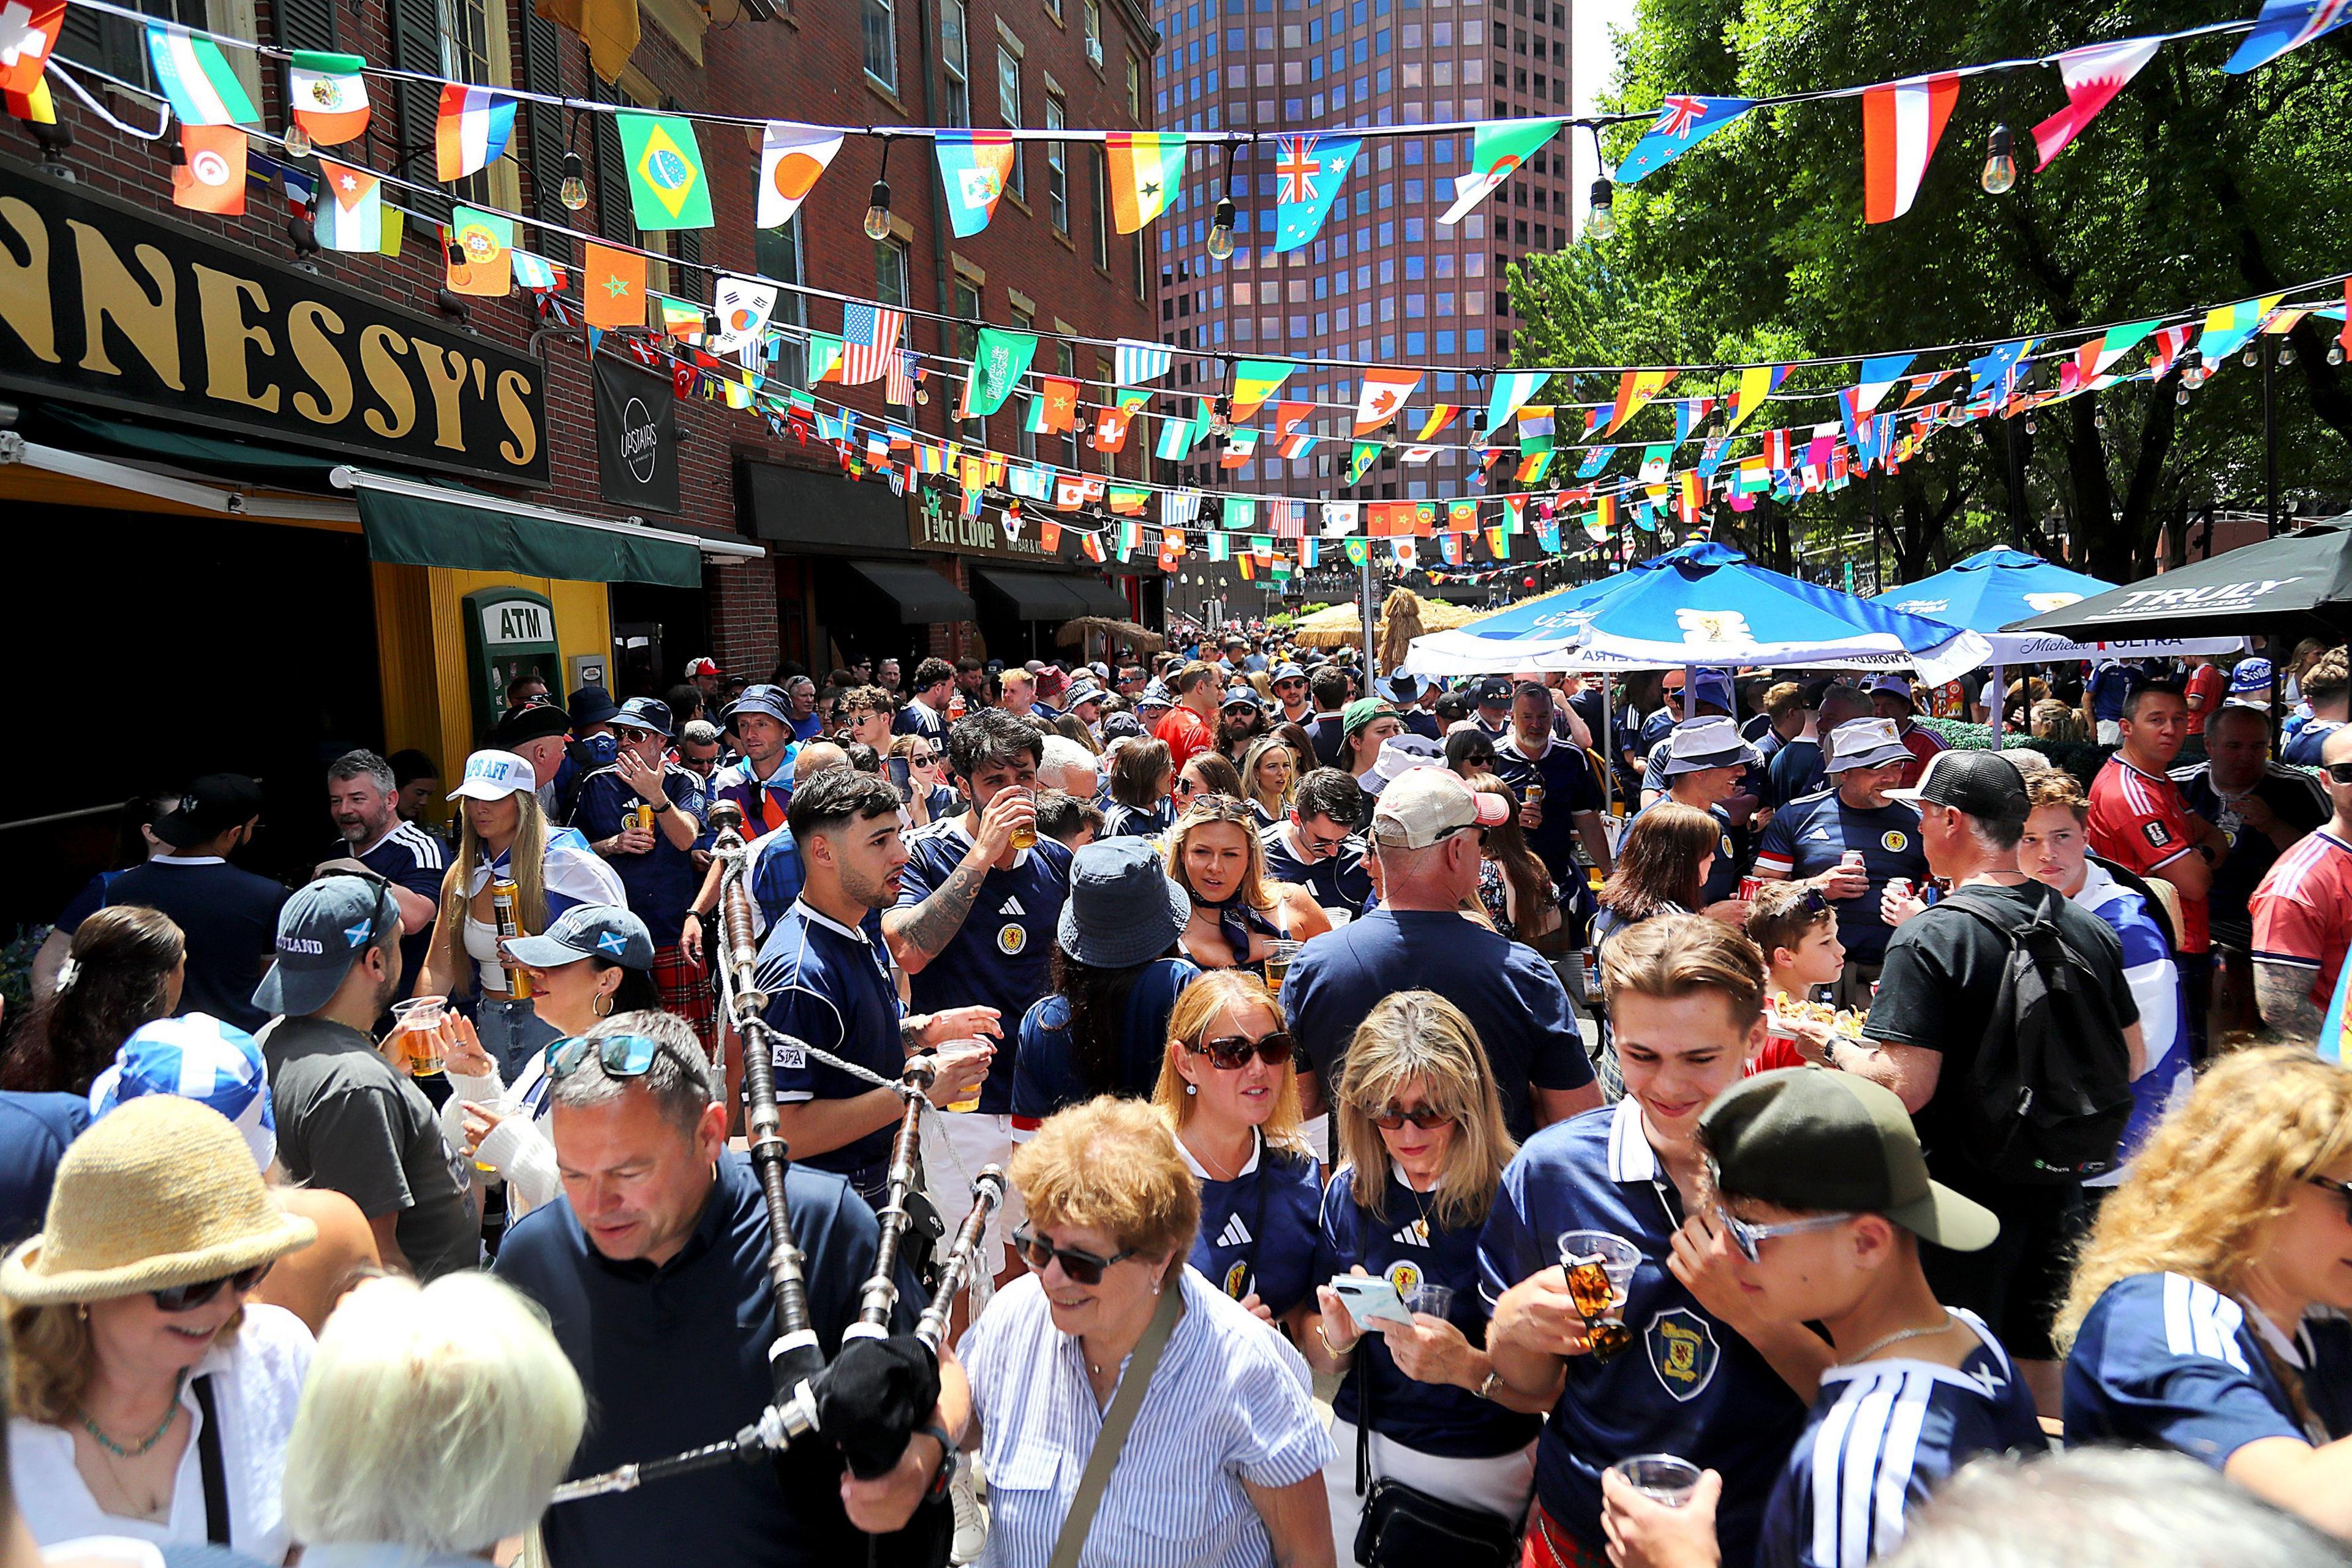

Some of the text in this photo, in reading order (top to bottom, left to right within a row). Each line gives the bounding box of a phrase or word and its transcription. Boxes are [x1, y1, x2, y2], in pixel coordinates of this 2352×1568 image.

[621, 423, 657, 458] UPSTAIRS
[959, 514, 995, 549] Cove
[1018, 538, 1030, 553] BAR
[1030, 539, 1035, 554] &
[2119, 576, 2304, 608] TRULY
[2106, 597, 2254, 615] HARD SELTZER
[501, 608, 542, 639] ATM
[483, 760, 509, 781] AFF
[775, 1049, 803, 1065] SFA
